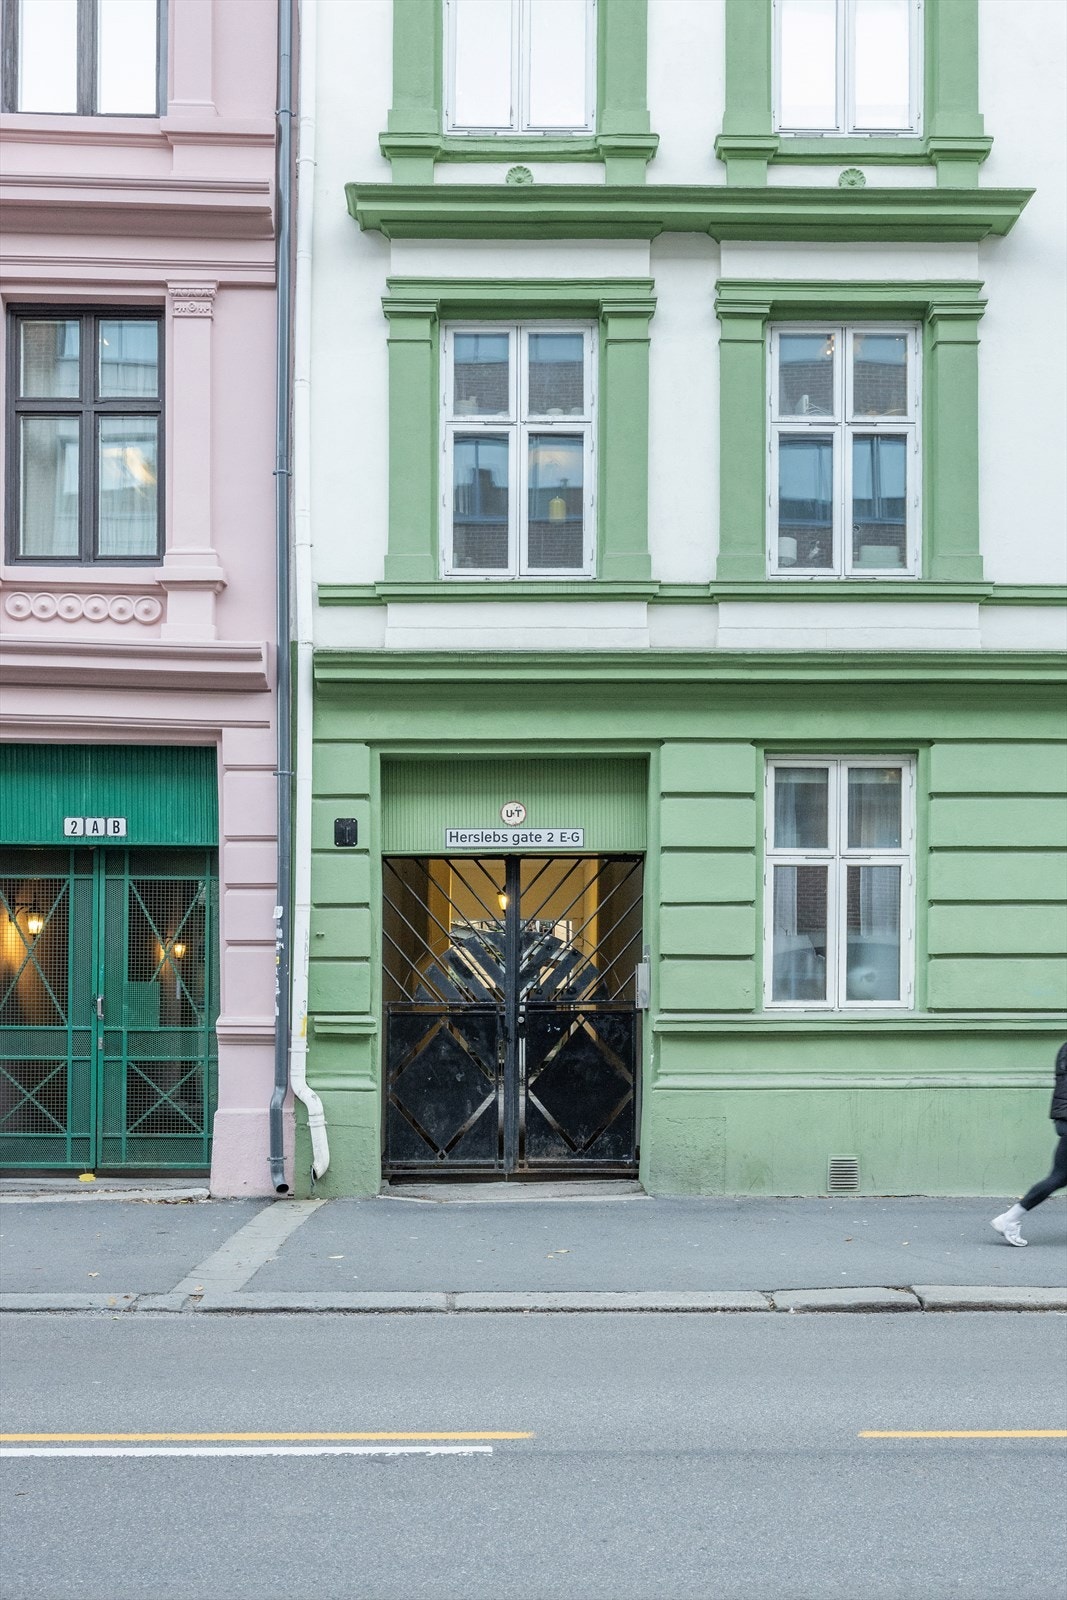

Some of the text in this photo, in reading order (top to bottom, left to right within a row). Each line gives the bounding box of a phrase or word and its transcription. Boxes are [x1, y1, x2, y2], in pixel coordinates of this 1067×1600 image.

[449, 831, 580, 845] Herslebs gate 2 E-G
